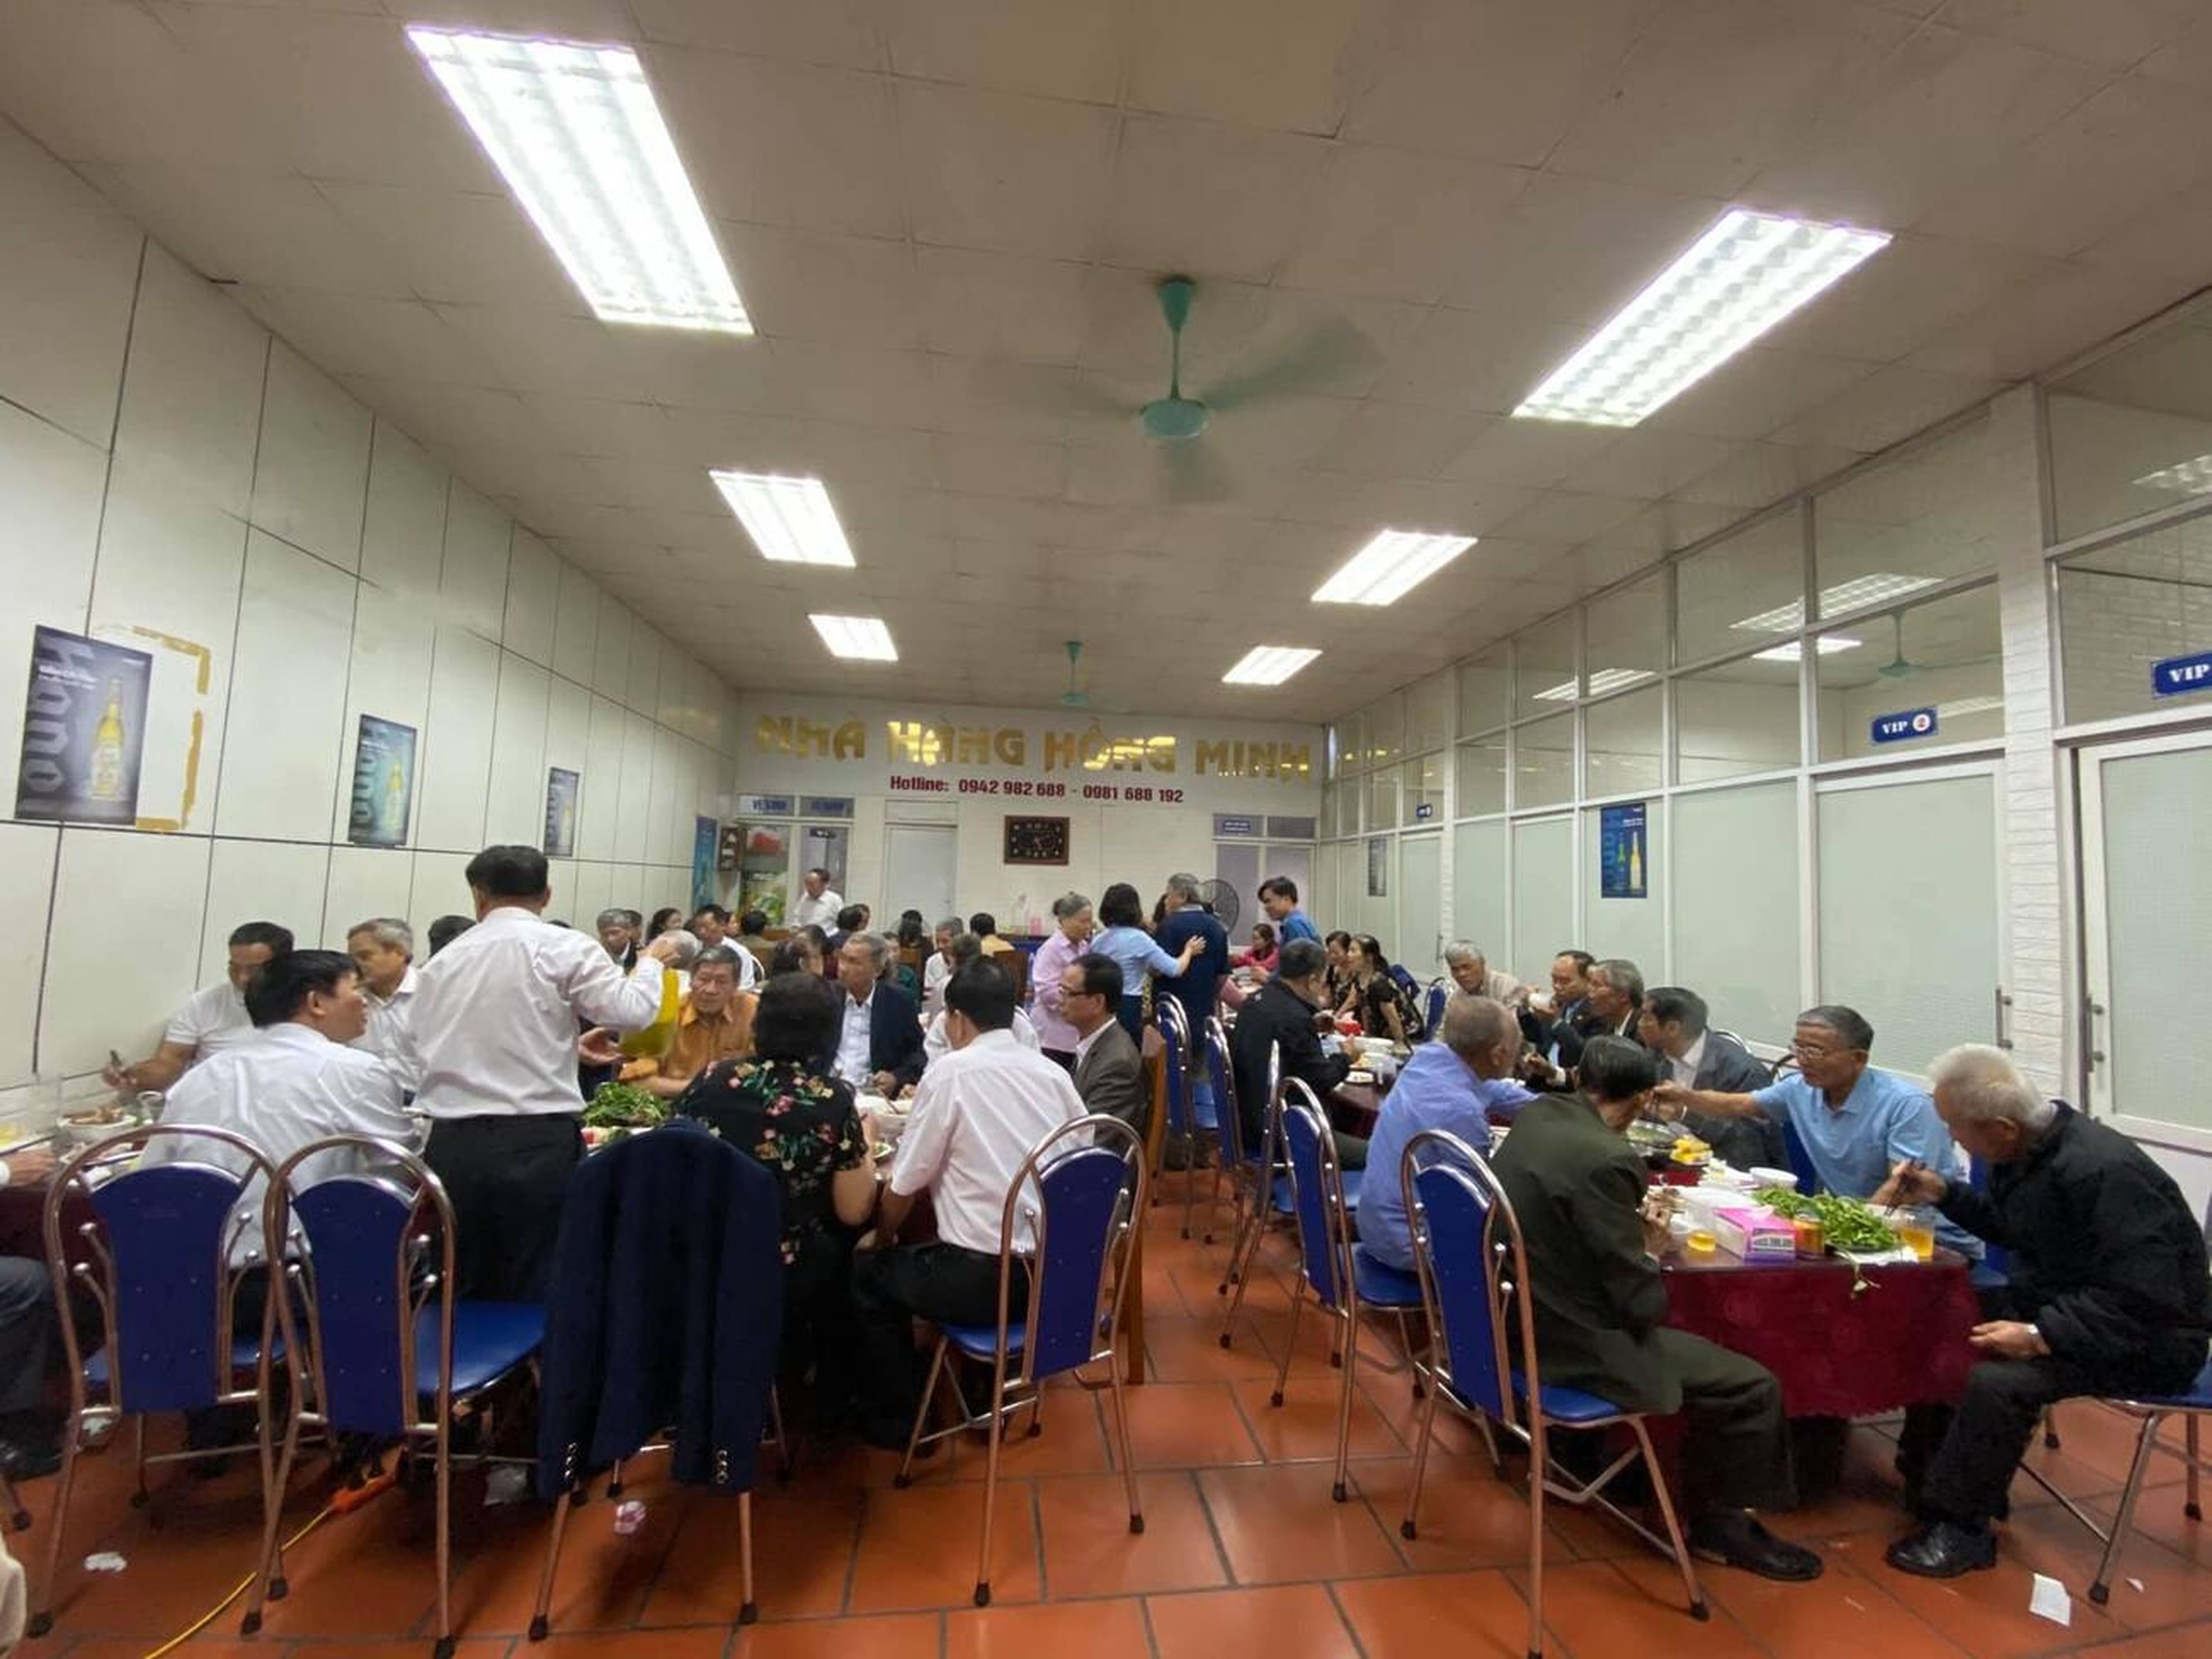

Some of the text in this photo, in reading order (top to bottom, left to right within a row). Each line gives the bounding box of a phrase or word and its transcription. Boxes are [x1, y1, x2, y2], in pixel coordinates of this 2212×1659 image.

[2168, 663, 2210, 683] VIP
[1881, 720, 1908, 735] VIP
[886, 711, 1025, 766] HÀNG
[1044, 717, 1176, 773] HỒNG
[1195, 739, 1310, 782] MINH
[890, 775, 949, 792] Hotline:
[959, 779, 999, 794] 0942
[1003, 781, 1033, 796] 982
[1036, 782, 1065, 797] 688
[1082, 785, 1118, 800] 0981
[1124, 787, 1153, 801] 688
[1158, 789, 1184, 803] 192
